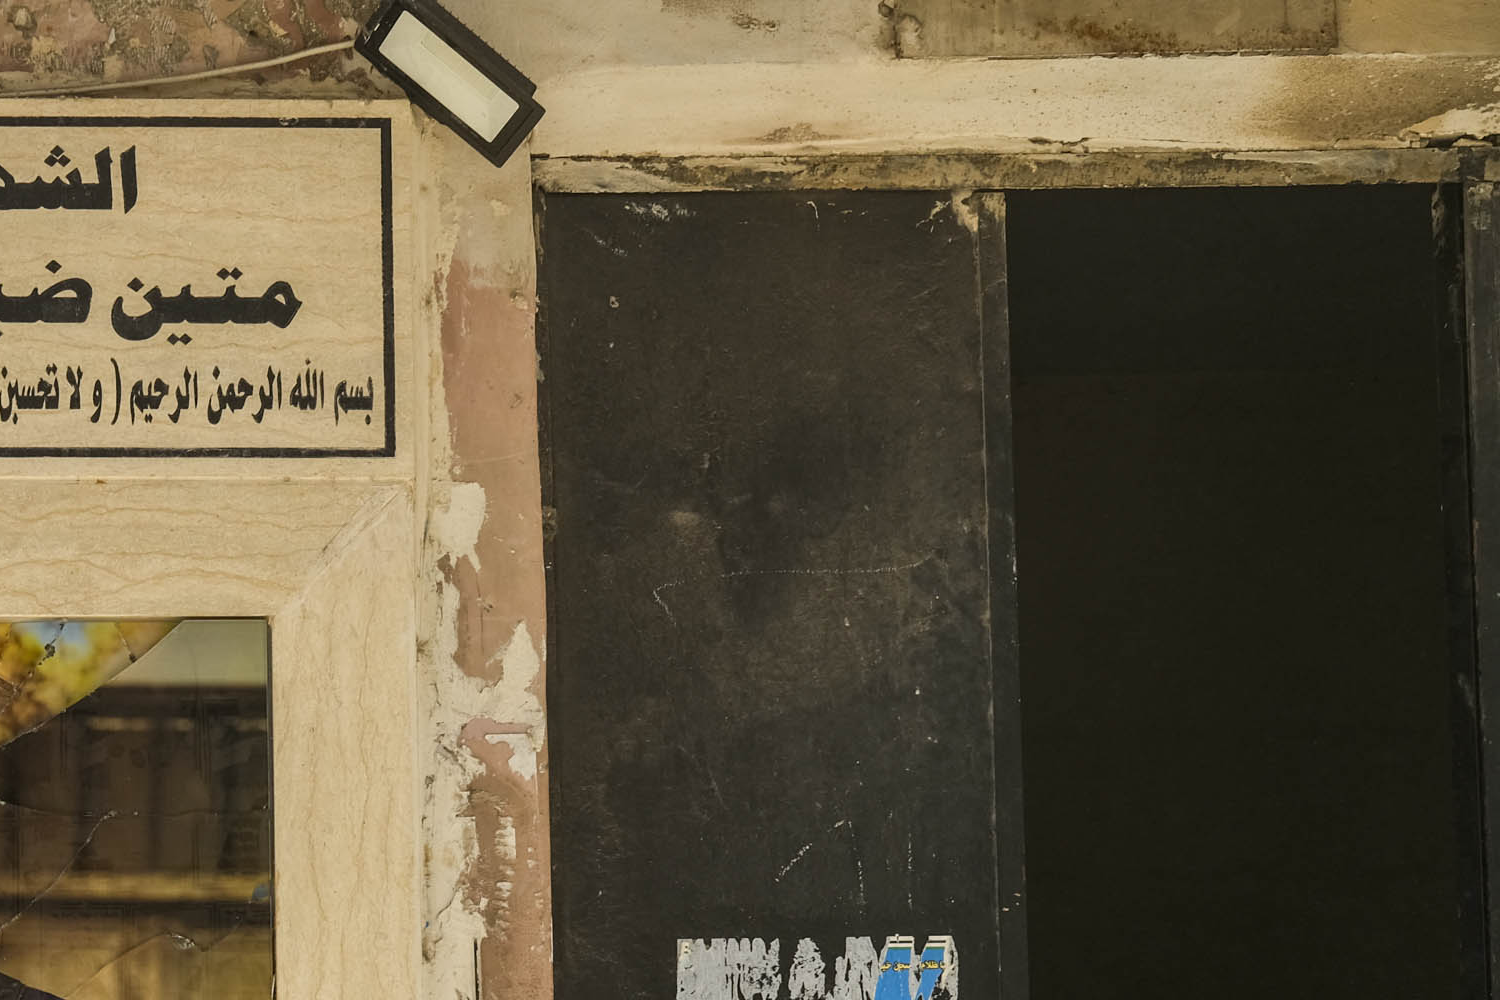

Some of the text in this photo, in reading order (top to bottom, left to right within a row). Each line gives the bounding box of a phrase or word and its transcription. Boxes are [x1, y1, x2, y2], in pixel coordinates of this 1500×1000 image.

[110, 266, 303, 346] متين
[129, 366, 199, 425] الرحيم
[207, 365, 283, 425] الرحمن
[289, 358, 326, 411] الله
[333, 376, 375, 425] بسم
